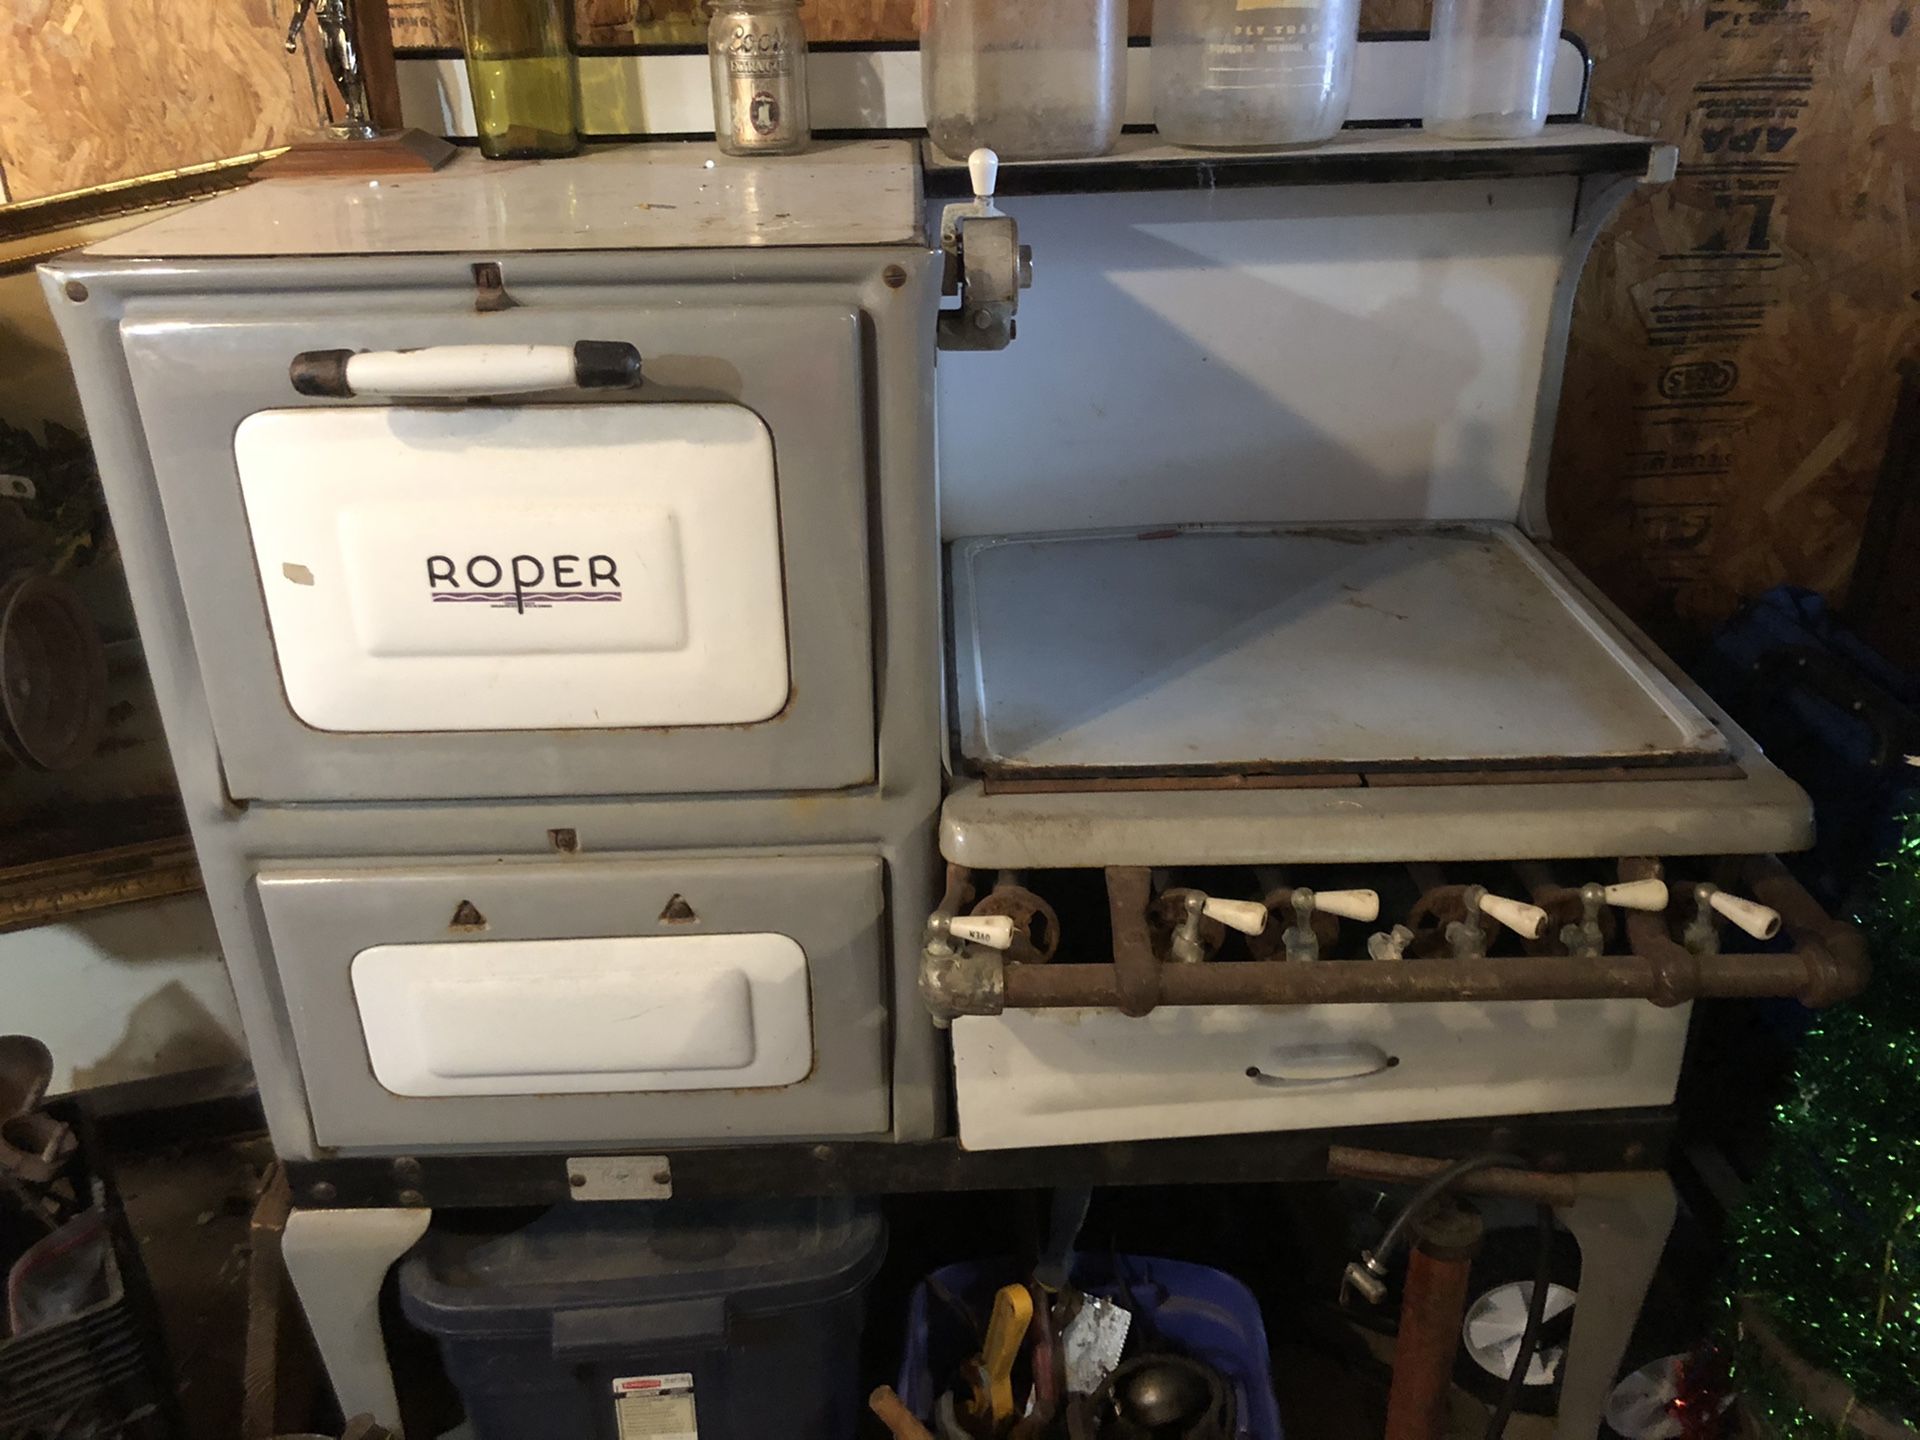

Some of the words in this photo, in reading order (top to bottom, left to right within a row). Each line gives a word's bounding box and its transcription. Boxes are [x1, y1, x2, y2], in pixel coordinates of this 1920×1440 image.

[1700, 126, 1798, 153] APA
[427, 554, 621, 615] ROPER
[969, 931, 991, 942] OVEN
